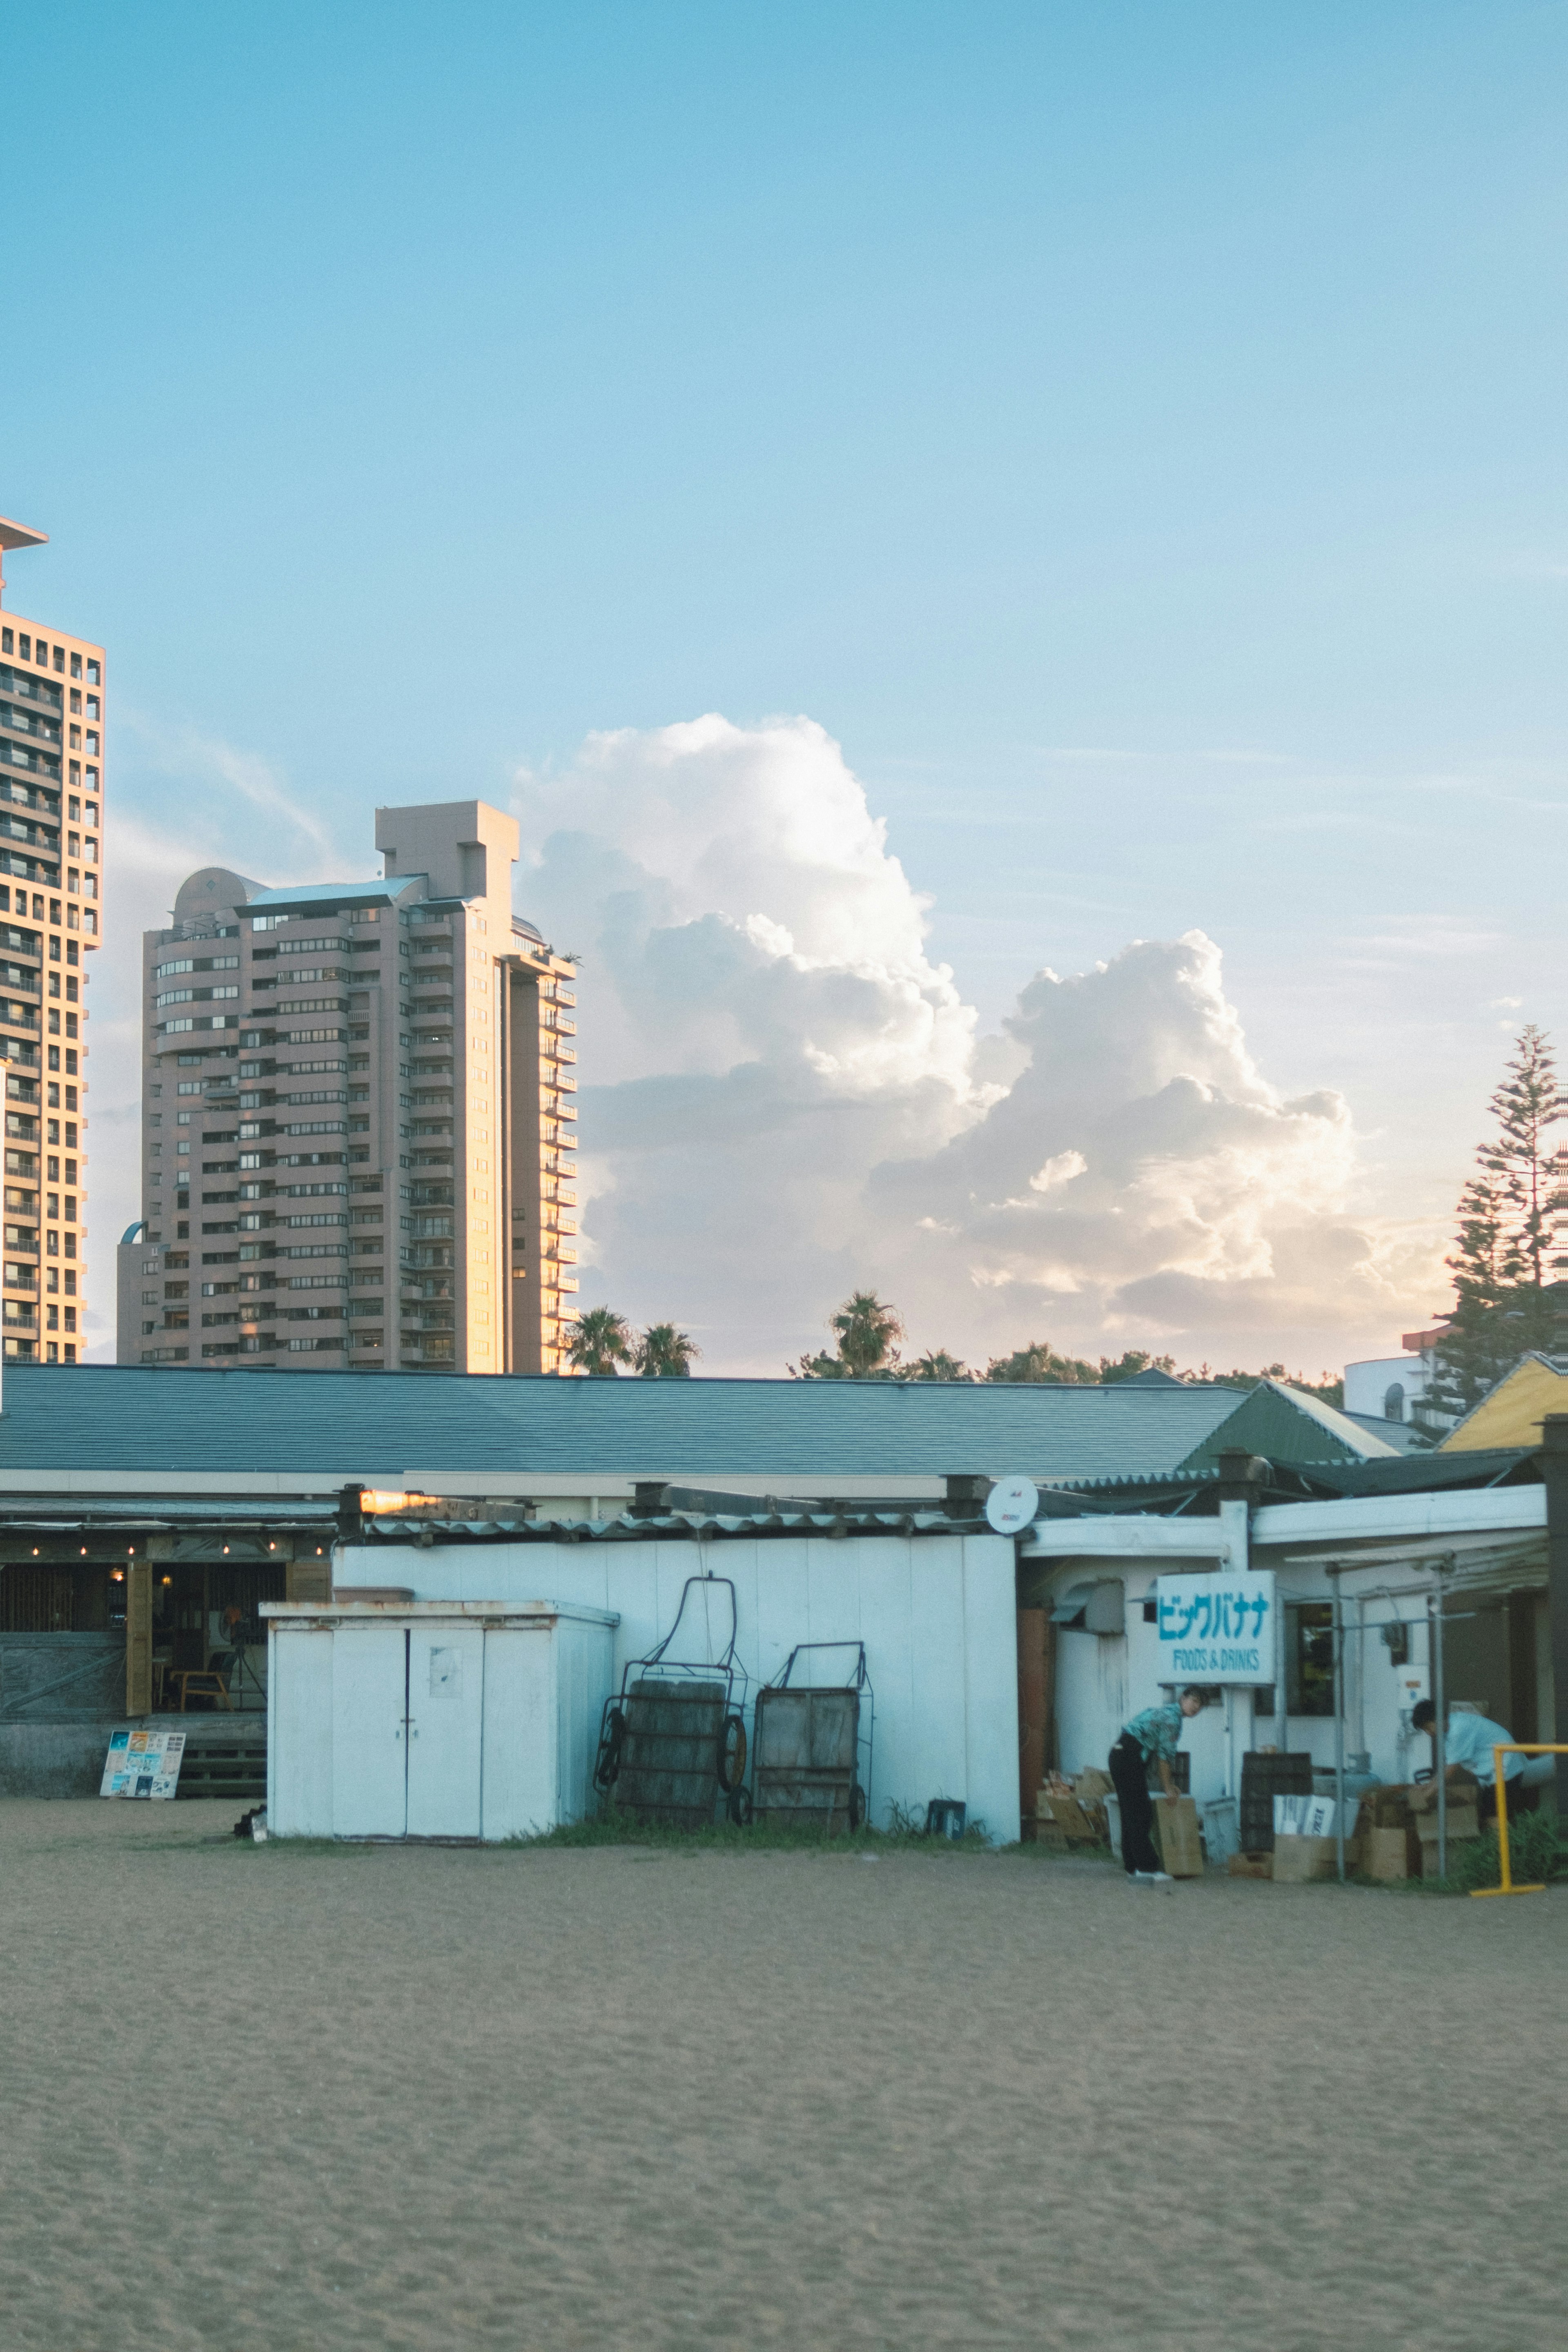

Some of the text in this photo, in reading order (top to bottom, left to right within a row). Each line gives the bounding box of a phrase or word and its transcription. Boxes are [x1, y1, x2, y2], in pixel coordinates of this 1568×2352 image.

[1173, 1648, 1260, 1671] FOODS & DRINKS
